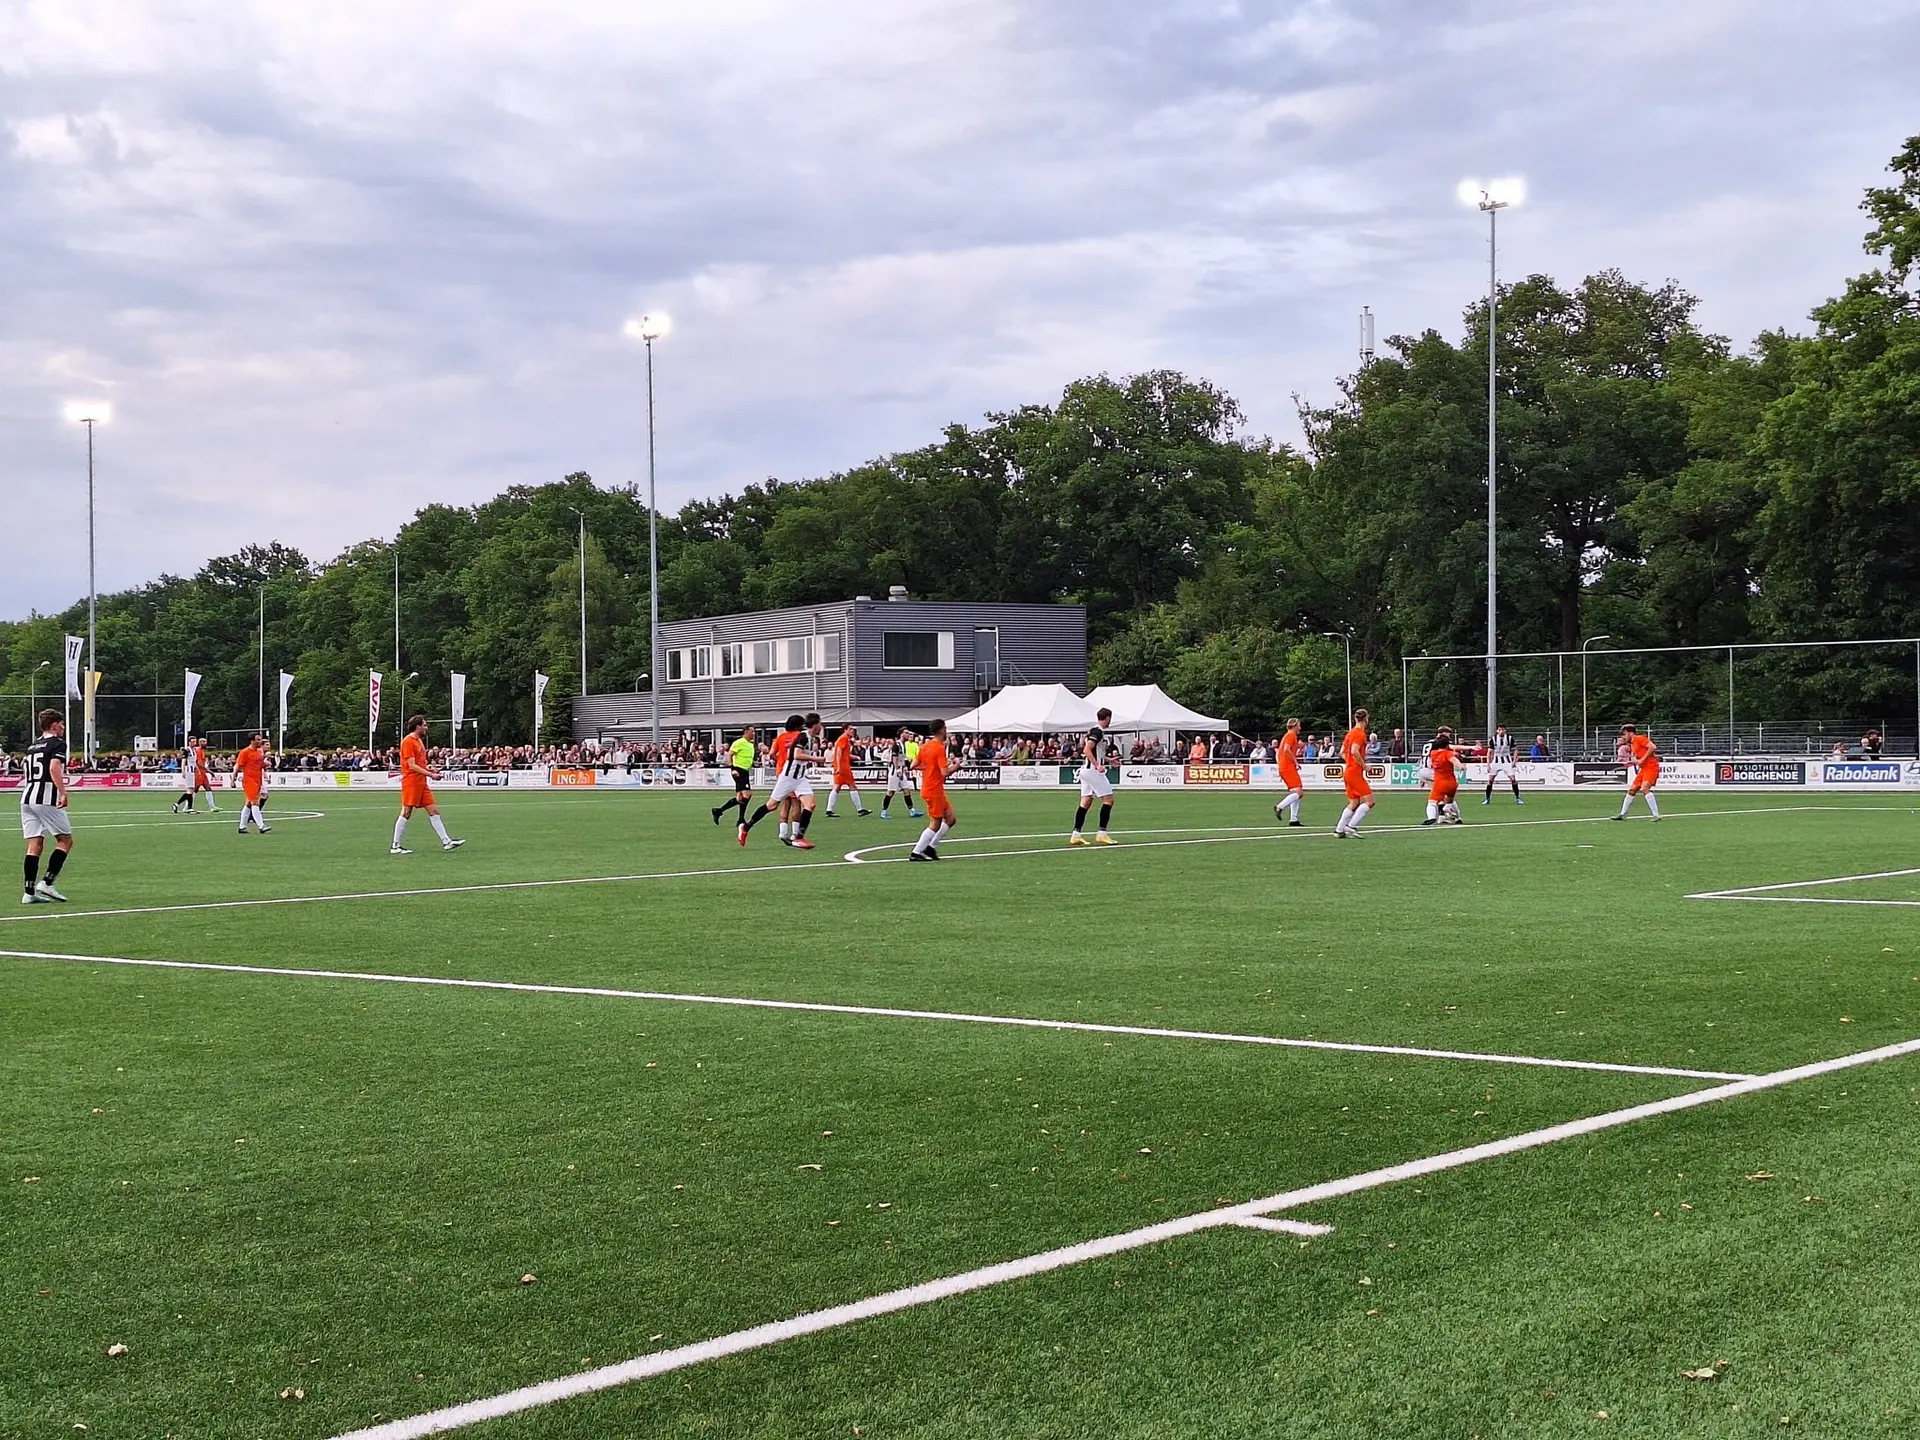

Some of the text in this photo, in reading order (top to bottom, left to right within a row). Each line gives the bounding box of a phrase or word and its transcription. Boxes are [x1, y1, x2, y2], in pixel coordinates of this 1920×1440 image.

[26, 752, 44, 780] 15
[557, 774, 576, 784] ING
[1189, 769, 1244, 779] BRUINS
[1392, 767, 1409, 783] bp
[1734, 771, 1798, 780] BORGHENDE
[1826, 766, 1898, 780] Rabobank
